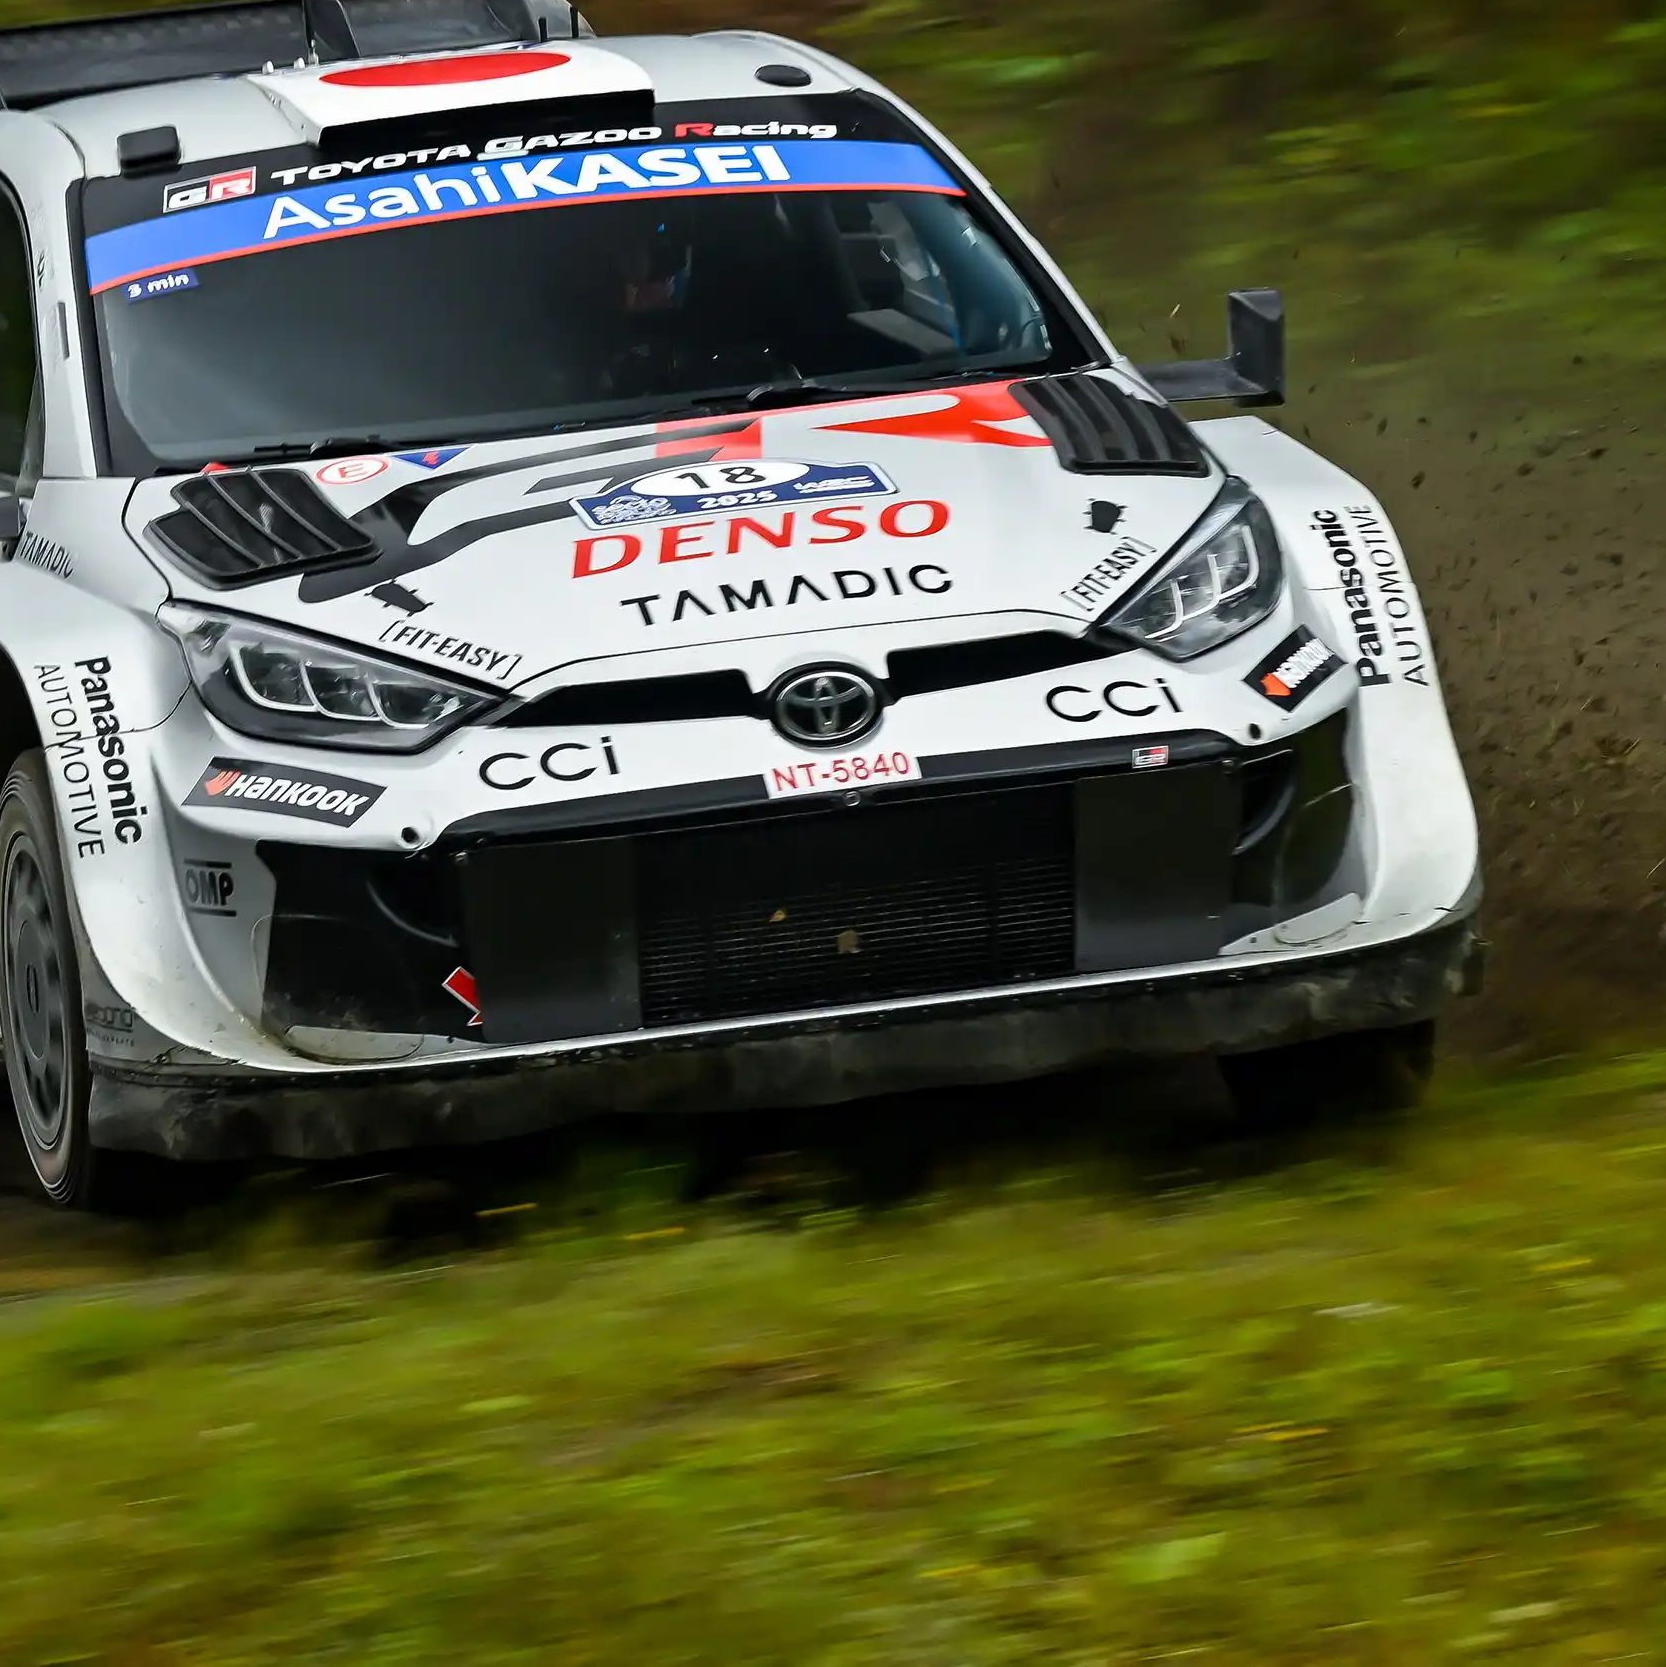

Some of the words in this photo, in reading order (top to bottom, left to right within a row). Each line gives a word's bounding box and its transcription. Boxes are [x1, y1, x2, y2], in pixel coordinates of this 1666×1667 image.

[270, 144, 471, 186] TOYOTA
[483, 125, 662, 155] GAZOO
[675, 121, 837, 139] Racing
[147, 274, 189, 293] min
[676, 466, 767, 489] 18
[697, 489, 778, 509] 2025
[20, 531, 74, 579] TAMADIC
[571, 500, 951, 579] DENSO
[620, 564, 953, 627] TAMADIC
[1309, 509, 1392, 687] Panasonic
[1344, 505, 1430, 687] AUTOMOTIVE
[33, 664, 105, 858] AUTOMOTIVE
[74, 656, 148, 845] Panasonic
[772, 751, 910, 791] NT-5840
[185, 869, 234, 907] OMP
